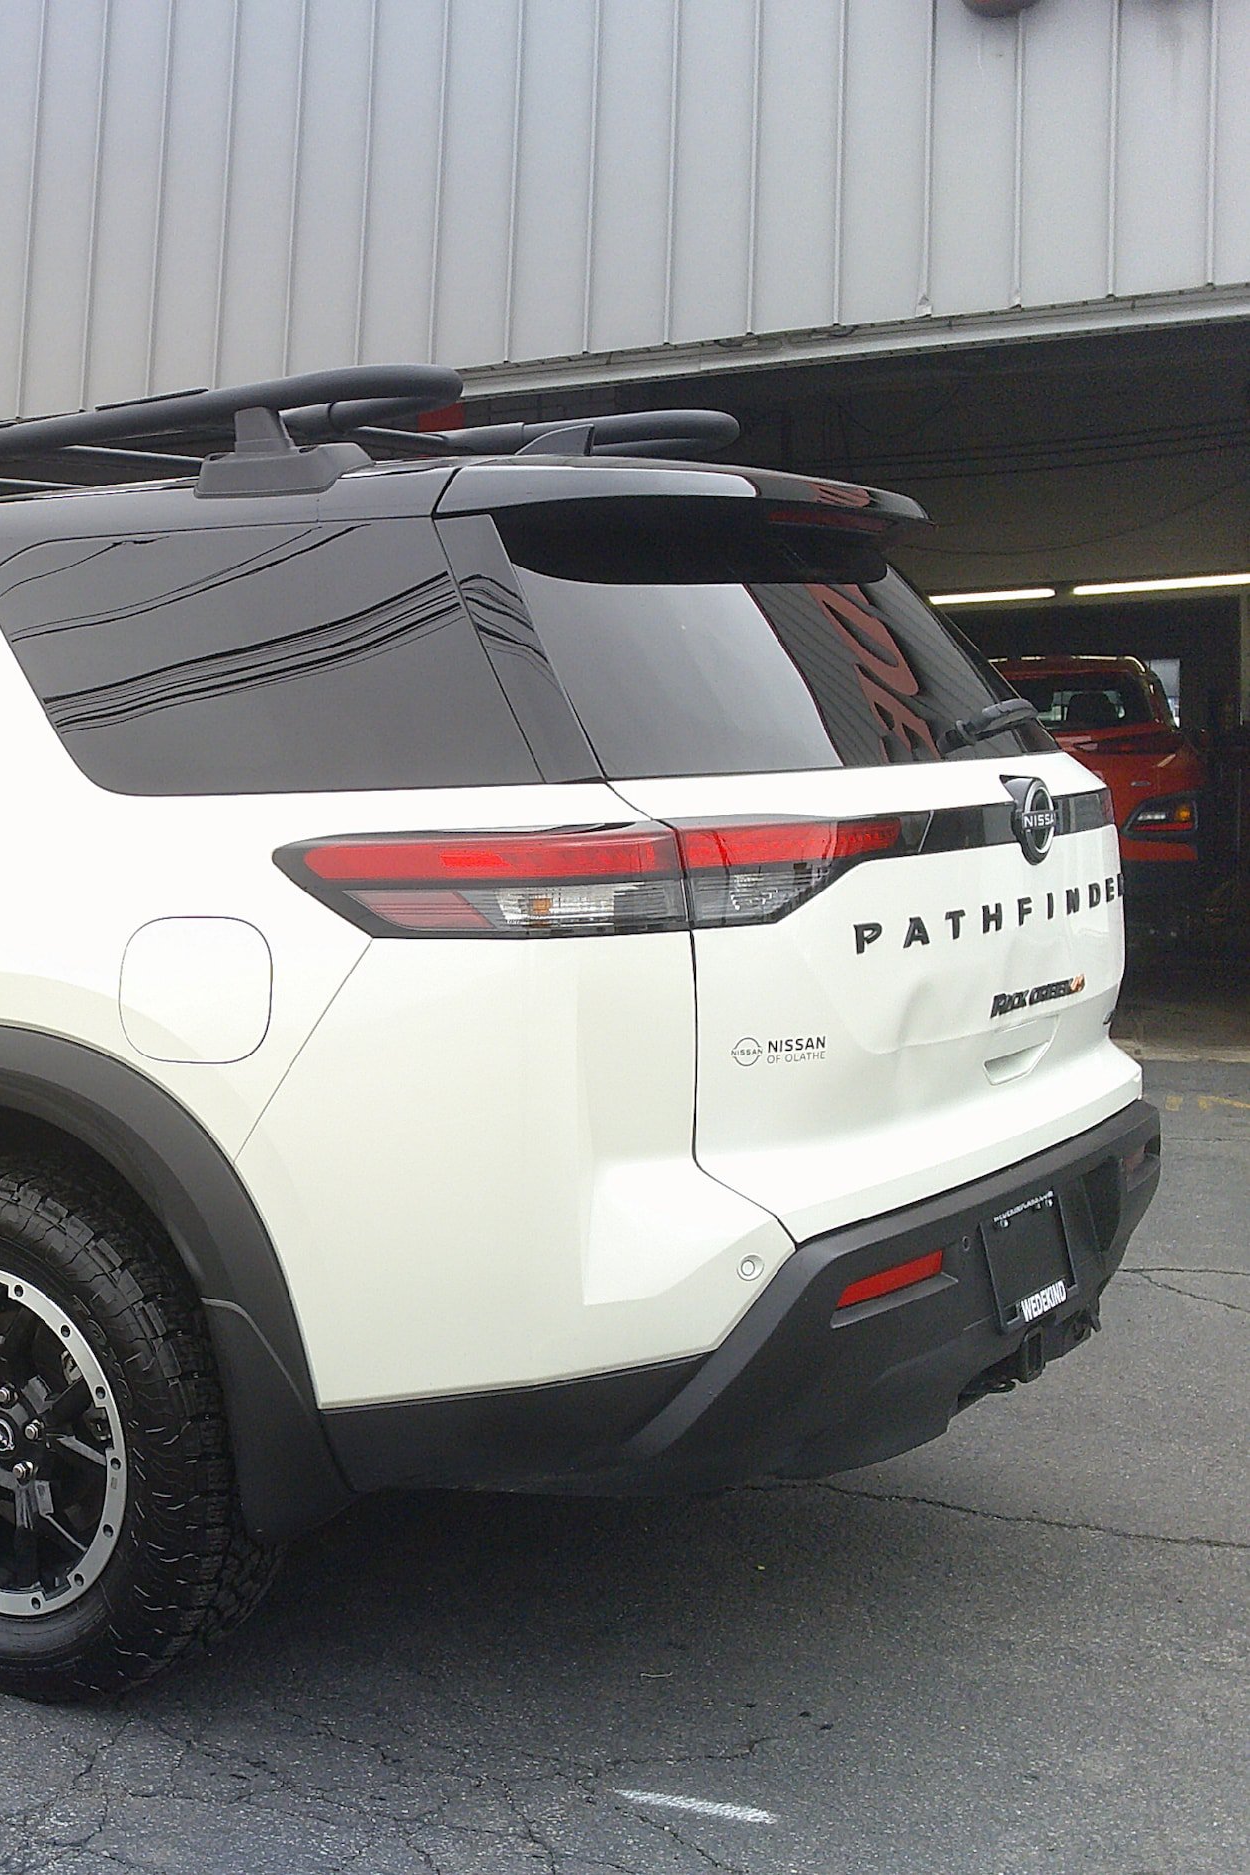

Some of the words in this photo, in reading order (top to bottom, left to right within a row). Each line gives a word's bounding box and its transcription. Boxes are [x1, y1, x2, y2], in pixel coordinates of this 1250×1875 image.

[1024, 813, 1054, 828] NISSA
[767, 1036, 826, 1053] NISSAN
[766, 1054, 780, 1064] OF
[784, 1051, 826, 1063] OLATHE
[1020, 1280, 1067, 1322] WEDEKIND
